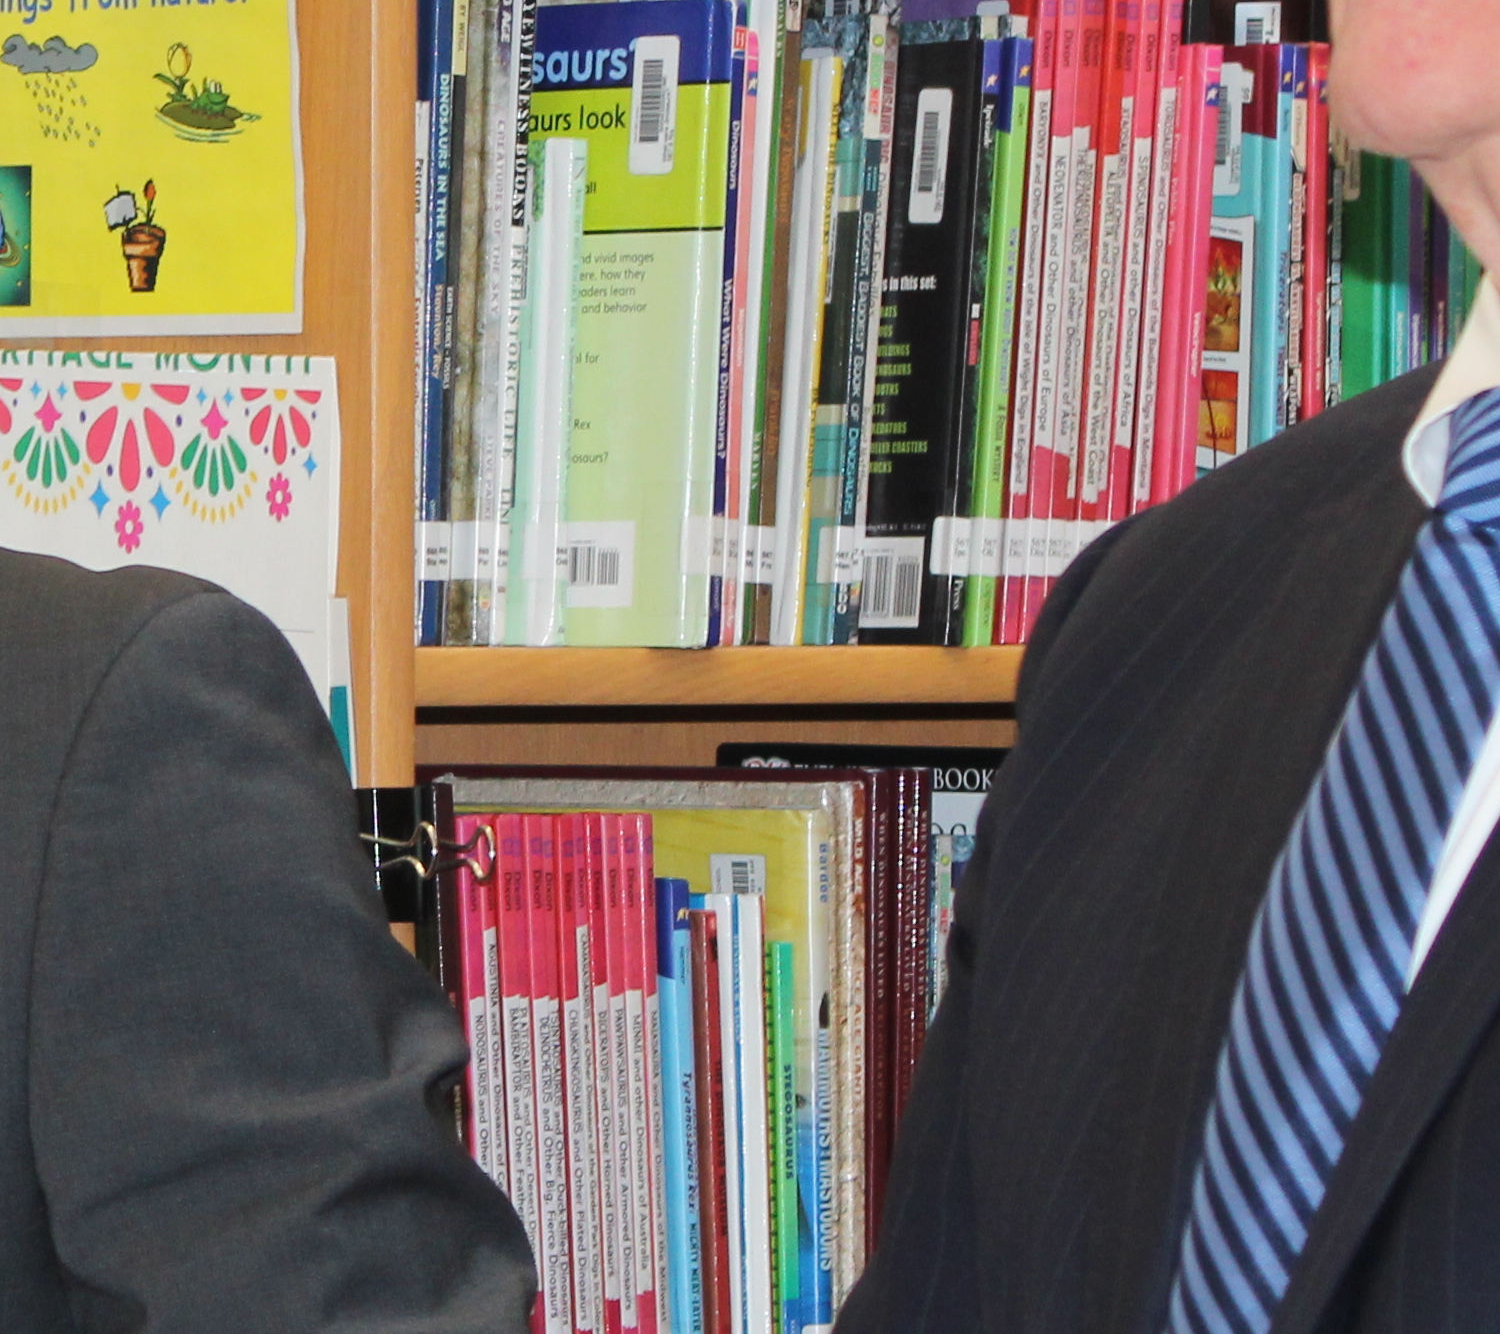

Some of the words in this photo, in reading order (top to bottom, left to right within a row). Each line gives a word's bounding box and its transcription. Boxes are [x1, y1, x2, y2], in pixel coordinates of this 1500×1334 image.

[437, 73, 451, 169] DINOSAURS
[578, 103, 627, 131] look
[511, 142, 529, 221] BOOKS
[436, 196, 447, 228] THE
[434, 230, 447, 262] SEA
[782, 1063, 796, 1181] STEGOSAURUS
